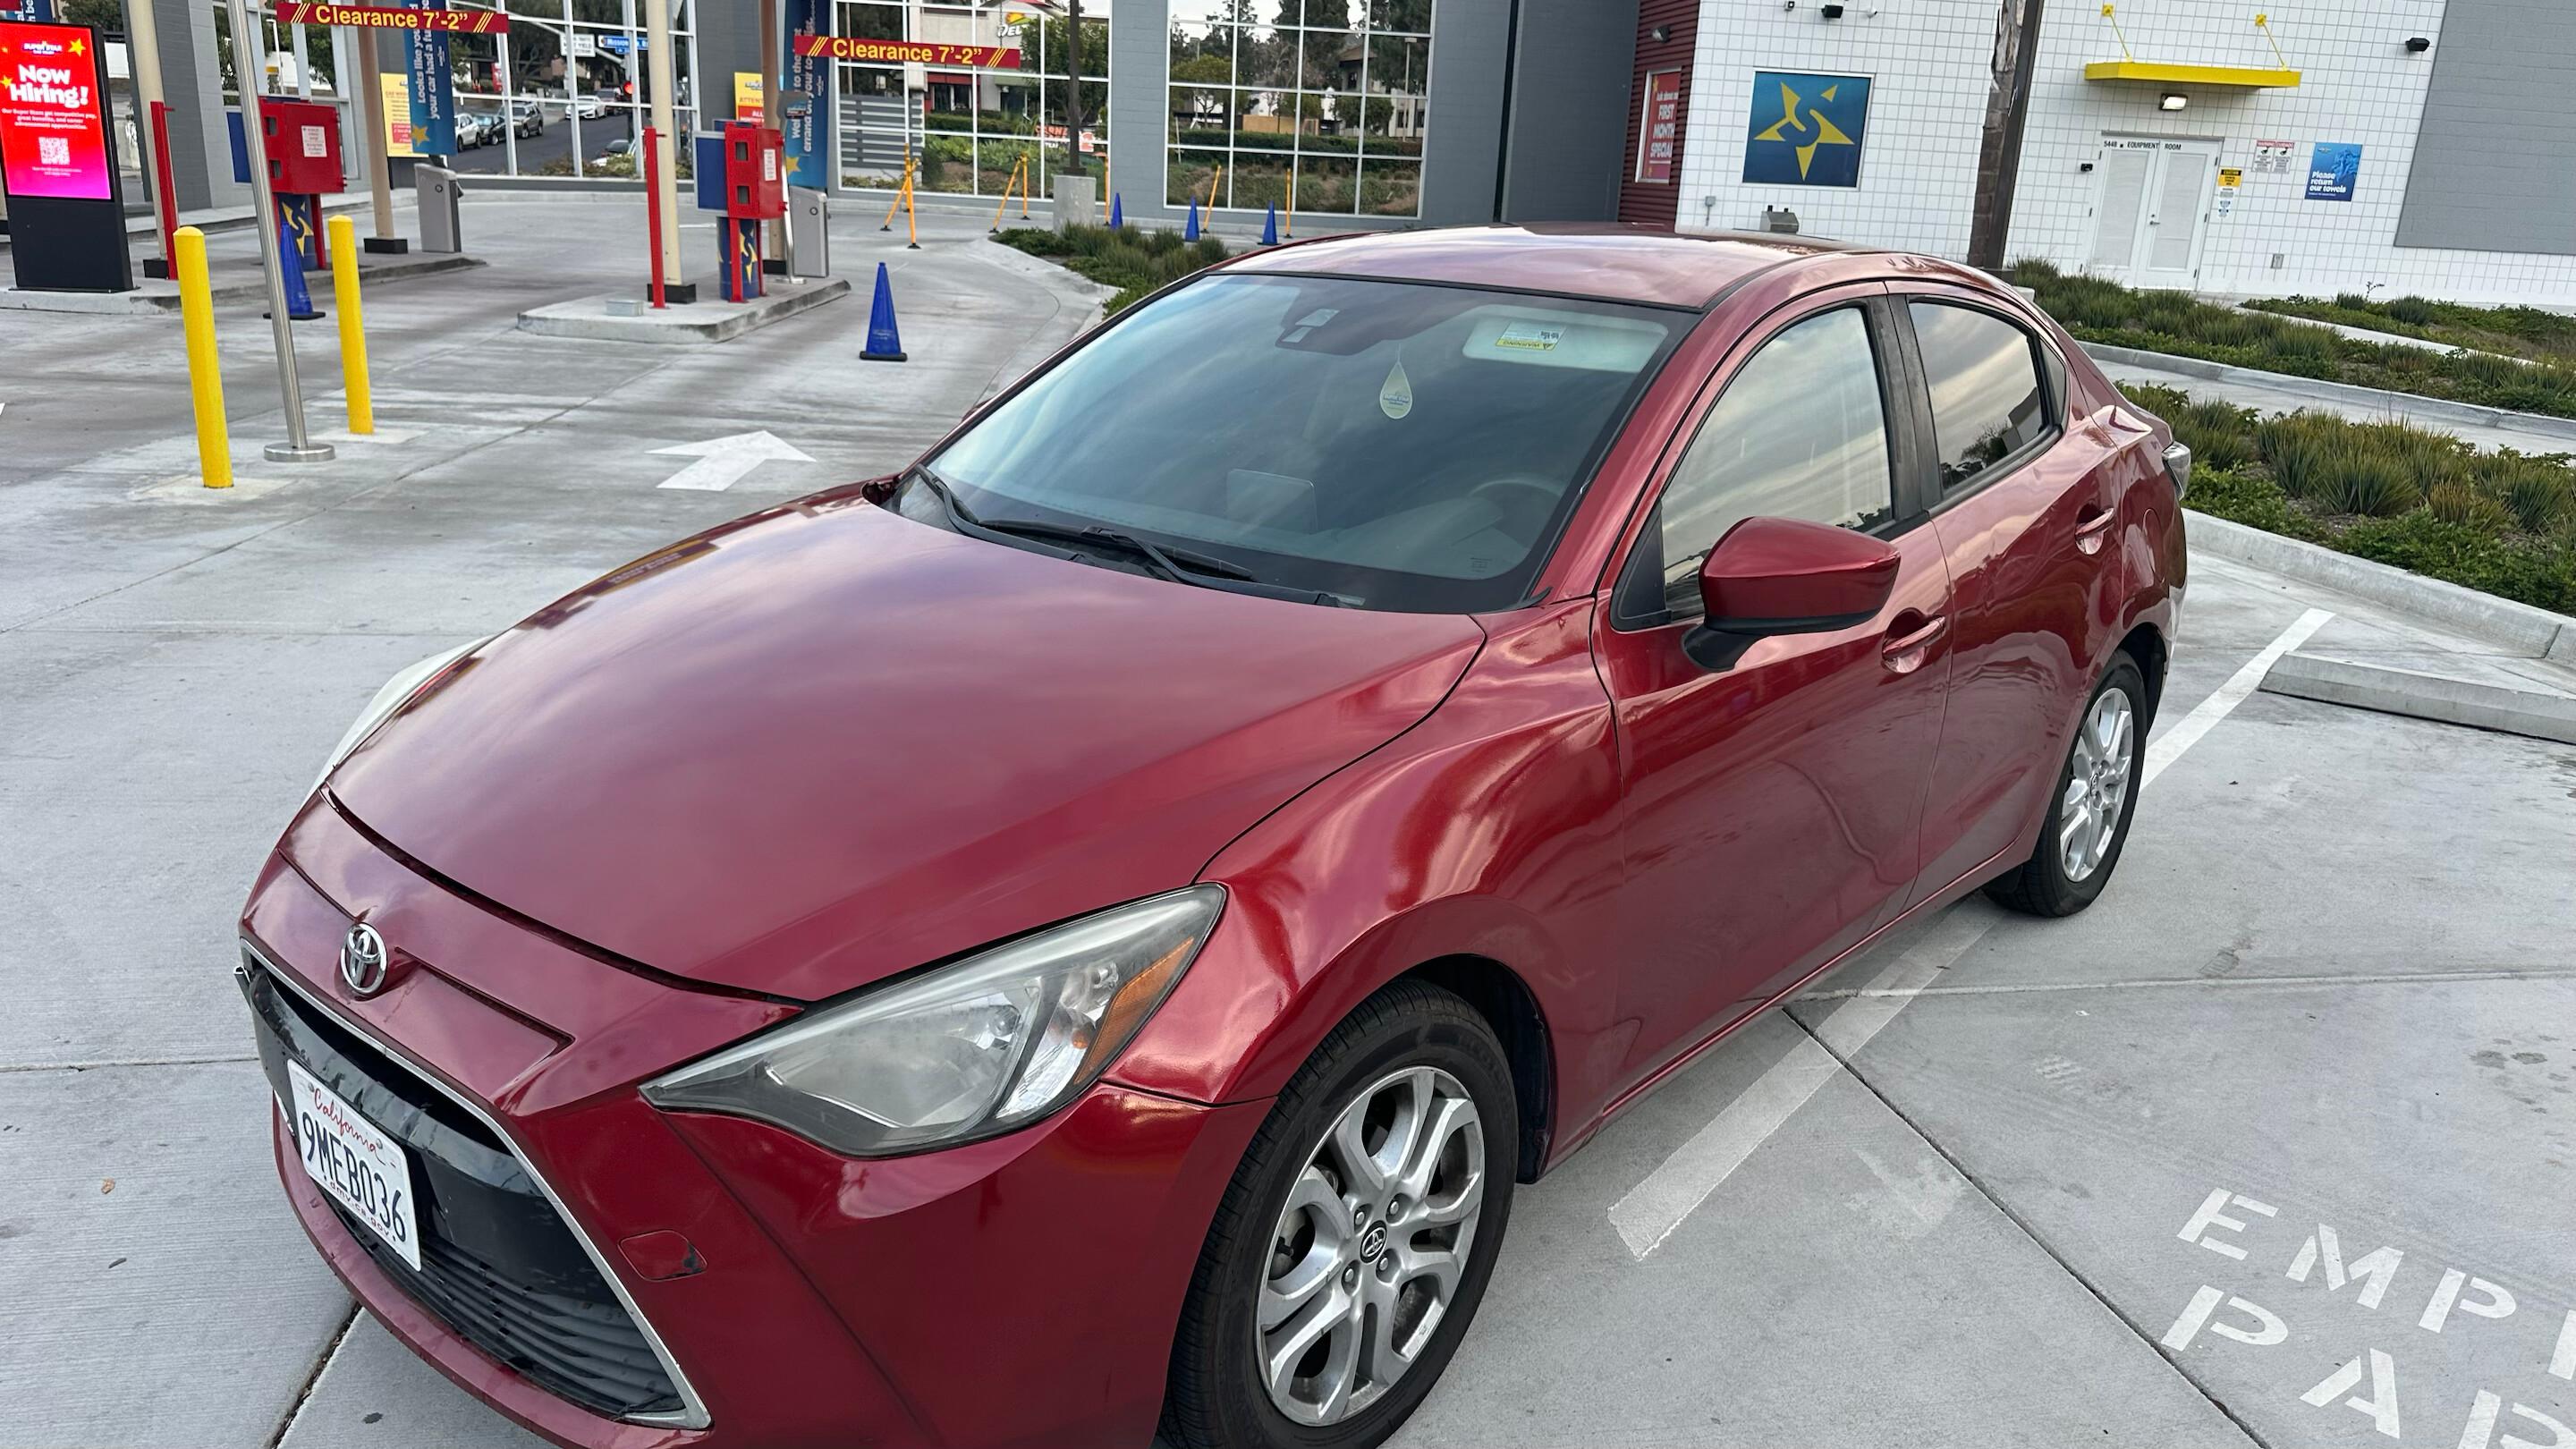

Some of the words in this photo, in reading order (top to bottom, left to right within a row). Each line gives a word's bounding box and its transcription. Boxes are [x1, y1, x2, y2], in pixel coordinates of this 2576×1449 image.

[316, 4, 418, 28] Clearance
[423, 30, 433, 44] fu
[997, 24, 1022, 37] DEL
[413, 48, 424, 69] like
[426, 45, 433, 53] a
[833, 38, 933, 62] Clearance
[18, 64, 71, 85] Now
[425, 54, 435, 74] had
[416, 71, 427, 104] Looks
[428, 77, 436, 93] car
[793, 73, 802, 88] to
[805, 73, 815, 98] your
[10, 82, 89, 109] Hiring!
[429, 96, 440, 120] your
[1658, 104, 1674, 120] FIRST
[804, 116, 812, 153] errand
[2311, 171, 2336, 179] Please
[2323, 184, 2346, 193] towels
[314, 1087, 386, 1166] California
[302, 1111, 407, 1243] 9MEB036
[329, 1181, 390, 1237] dmv.ca.gov
